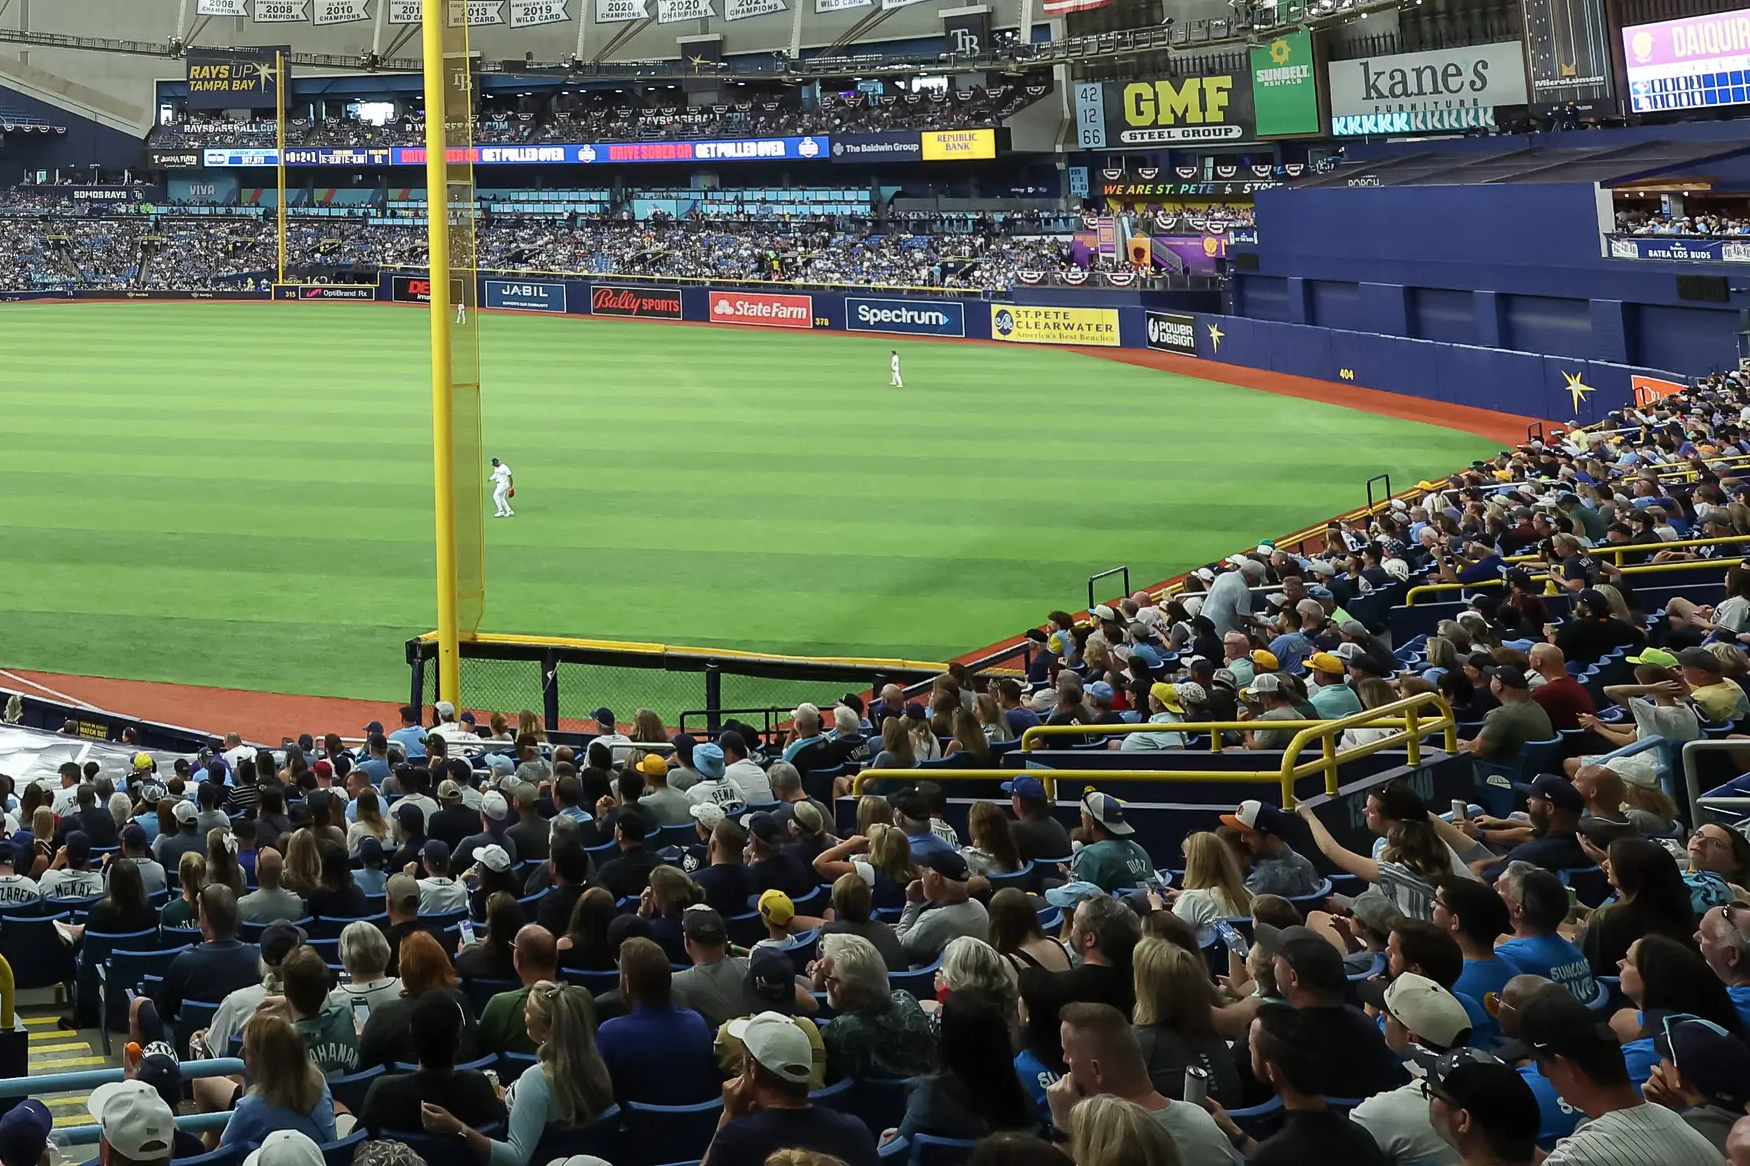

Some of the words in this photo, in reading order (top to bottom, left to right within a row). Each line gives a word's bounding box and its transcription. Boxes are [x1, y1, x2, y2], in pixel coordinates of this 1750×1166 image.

[209, 0, 234, 8] 2008
[266, 5, 293, 13] 2008
[608, 2, 633, 11] 2020
[670, 0, 699, 11] 2020
[730, 3, 779, 16] CHAMPIONS
[821, 0, 840, 8] WILD
[202, 6, 240, 15] CHAMPIONS
[326, 6, 353, 16] 2010
[461, 7, 487, 16] 2013
[523, 5, 552, 16] 2019
[662, 9, 708, 19] CHAMPIONS
[319, 13, 361, 21] CHAMPIONS
[453, 16, 472, 24] WILD
[515, 15, 536, 23] WILD
[539, 13, 561, 21] CARD
[190, 65, 230, 78] RAYS
[232, 64, 253, 78] UP
[1256, 65, 1310, 82] SUNBELT
[1264, 78, 1302, 87] RENTALS
[1359, 59, 1489, 100] kane's
[1535, 75, 1604, 87] MicroLumen
[190, 80, 229, 91] TAMPA
[232, 80, 256, 90] BAY
[1080, 86, 1098, 102] 42
[1123, 75, 1233, 127] GMF
[1374, 98, 1479, 114] FURNITURE
[1083, 107, 1098, 123] 12
[937, 132, 977, 143] REPUBLIC
[1083, 129, 1101, 145] 66
[1128, 131, 1176, 141] STEEL
[1181, 127, 1233, 138] GROUP
[609, 144, 639, 160] DRIVE
[641, 144, 675, 160] SOBER
[677, 143, 693, 158] OR
[695, 142, 717, 158] GET
[717, 141, 757, 157] PULLED
[758, 140, 786, 157] OVER
[845, 144, 861, 153] The
[861, 142, 893, 153] Baldwin
[893, 142, 919, 153] Group
[945, 142, 970, 151] BANK
[401, 149, 427, 162] DRIV
[481, 147, 501, 161] GET
[502, 147, 538, 161] PULLED
[538, 147, 565, 161] OVER
[73, 190, 104, 199] SOMOS
[104, 190, 127, 199] RAYS
[189, 184, 215, 195] VIVA
[1103, 184, 1123, 195] WE
[1126, 184, 1152, 194] ARE
[1155, 184, 1175, 194] ST.
[1179, 184, 1214, 194] PETE
[1648, 249, 1671, 258] BATEA
[1673, 250, 1688, 259] LOS
[1690, 251, 1711, 259] BUDS
[285, 290, 296, 298] 315
[323, 289, 357, 298] OptiBrand
[358, 289, 368, 298] Rx
[501, 284, 549, 297] JABIL
[593, 288, 642, 315] Bally
[642, 295, 680, 312] SPORTS
[858, 304, 944, 326] Spectrum
[814, 317, 830, 326] 378
[1015, 321, 1114, 333] CLEARWATER
[1017, 331, 1057, 341] America's
[1059, 332, 1079, 341] Best
[1080, 332, 1114, 342] Beaches
[1339, 368, 1354, 380] 404
[79, 726, 95, 736] WATCH
[96, 730, 108, 738] OUT
